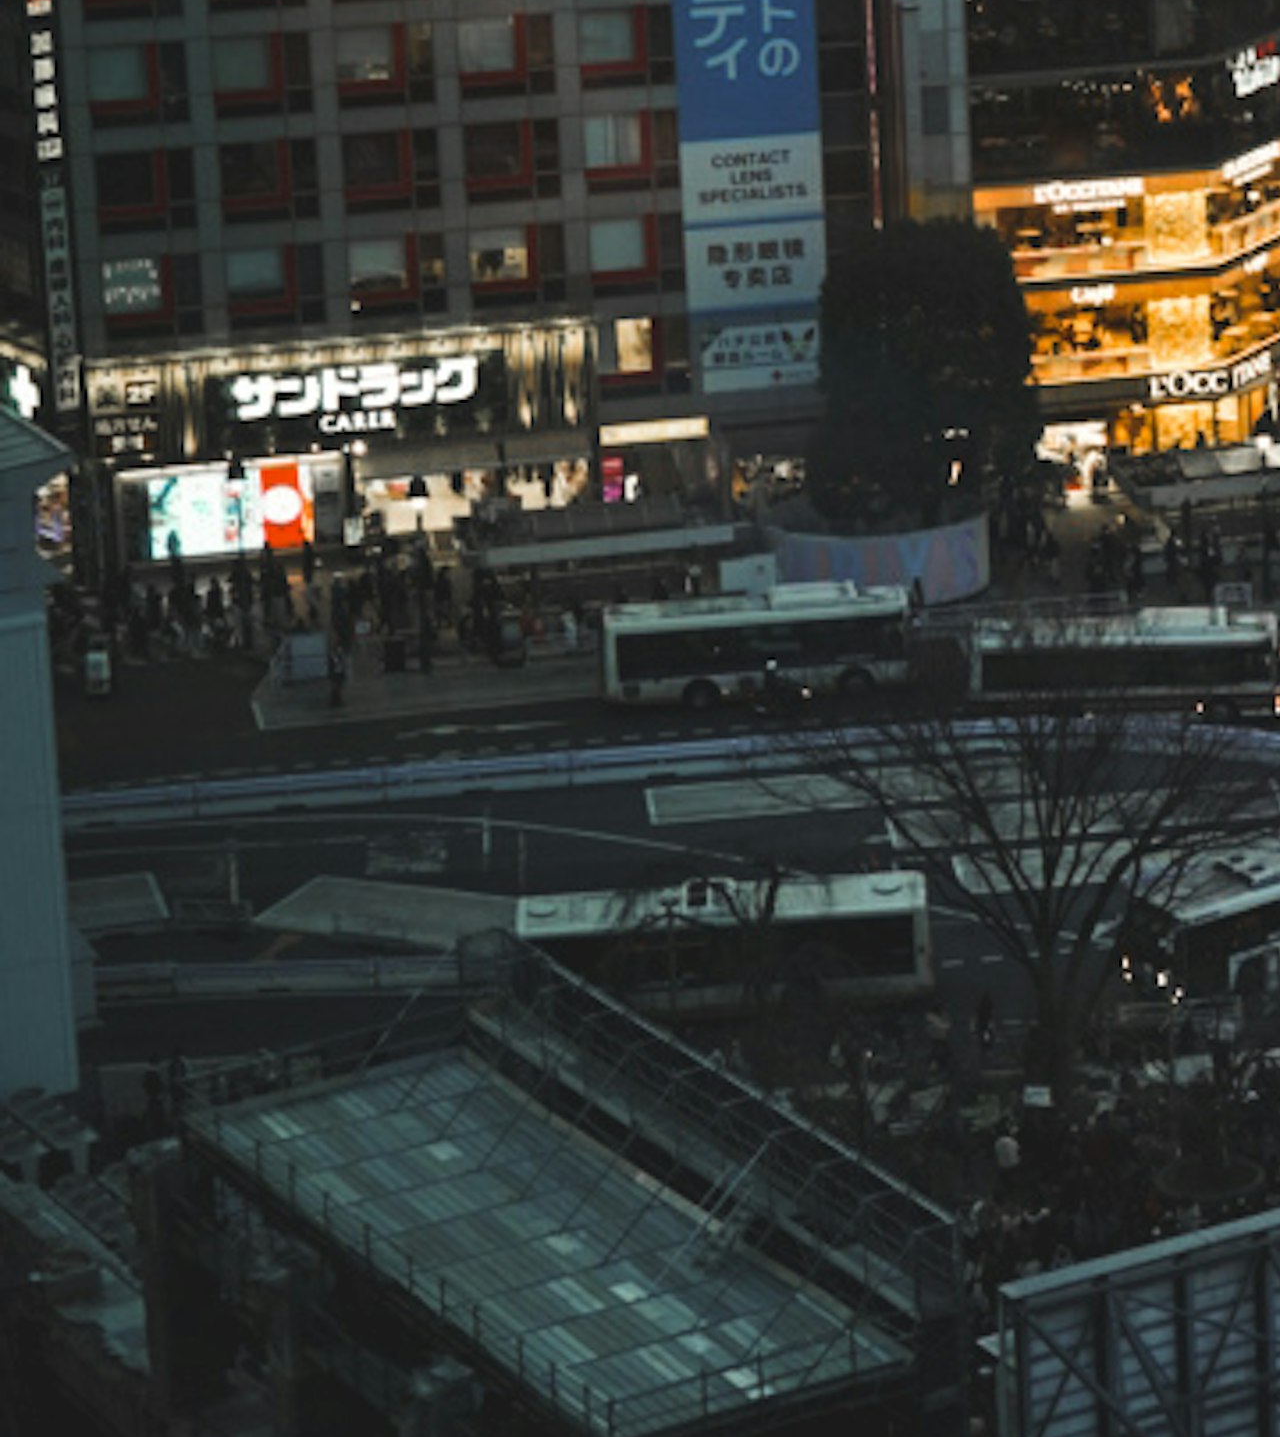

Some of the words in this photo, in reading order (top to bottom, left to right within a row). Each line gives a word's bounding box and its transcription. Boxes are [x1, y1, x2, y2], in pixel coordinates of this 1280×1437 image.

[711, 149, 790, 168] CONTACT
[730, 169, 773, 185] LENS
[700, 183, 807, 203] SPECIALISTS
[231, 356, 479, 422] サンドラッグ
